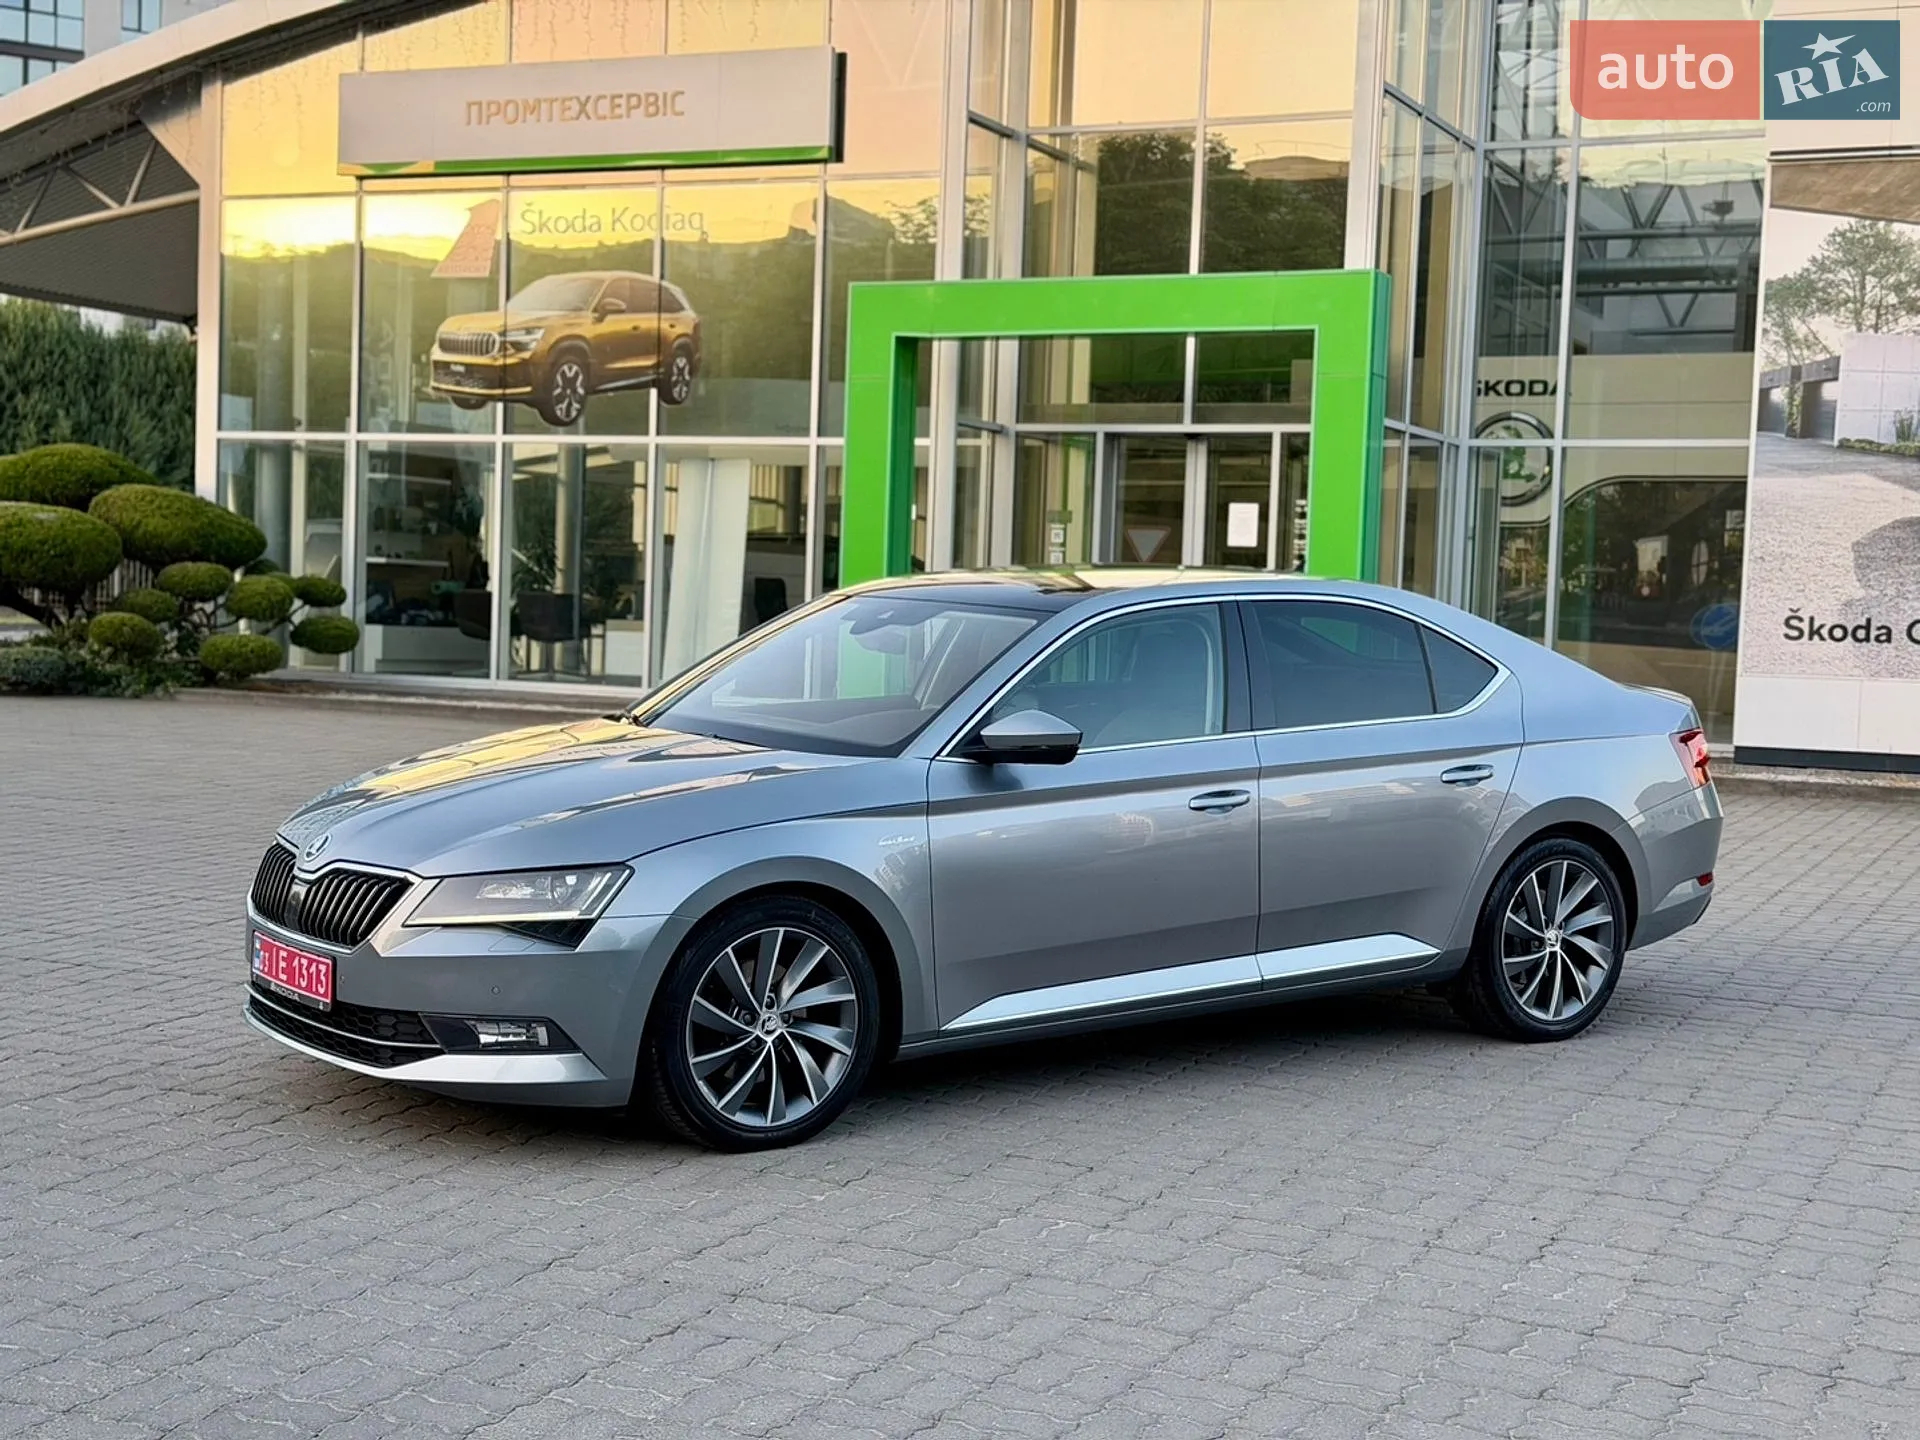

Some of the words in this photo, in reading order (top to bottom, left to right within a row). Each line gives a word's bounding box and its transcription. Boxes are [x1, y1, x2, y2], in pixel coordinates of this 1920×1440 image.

[465, 90, 686, 126] ПРОМТЕХСЕРВІС
[520, 202, 602, 235] Škoda
[1783, 607, 1893, 643] Škoda
[292, 956, 328, 995] 1313
